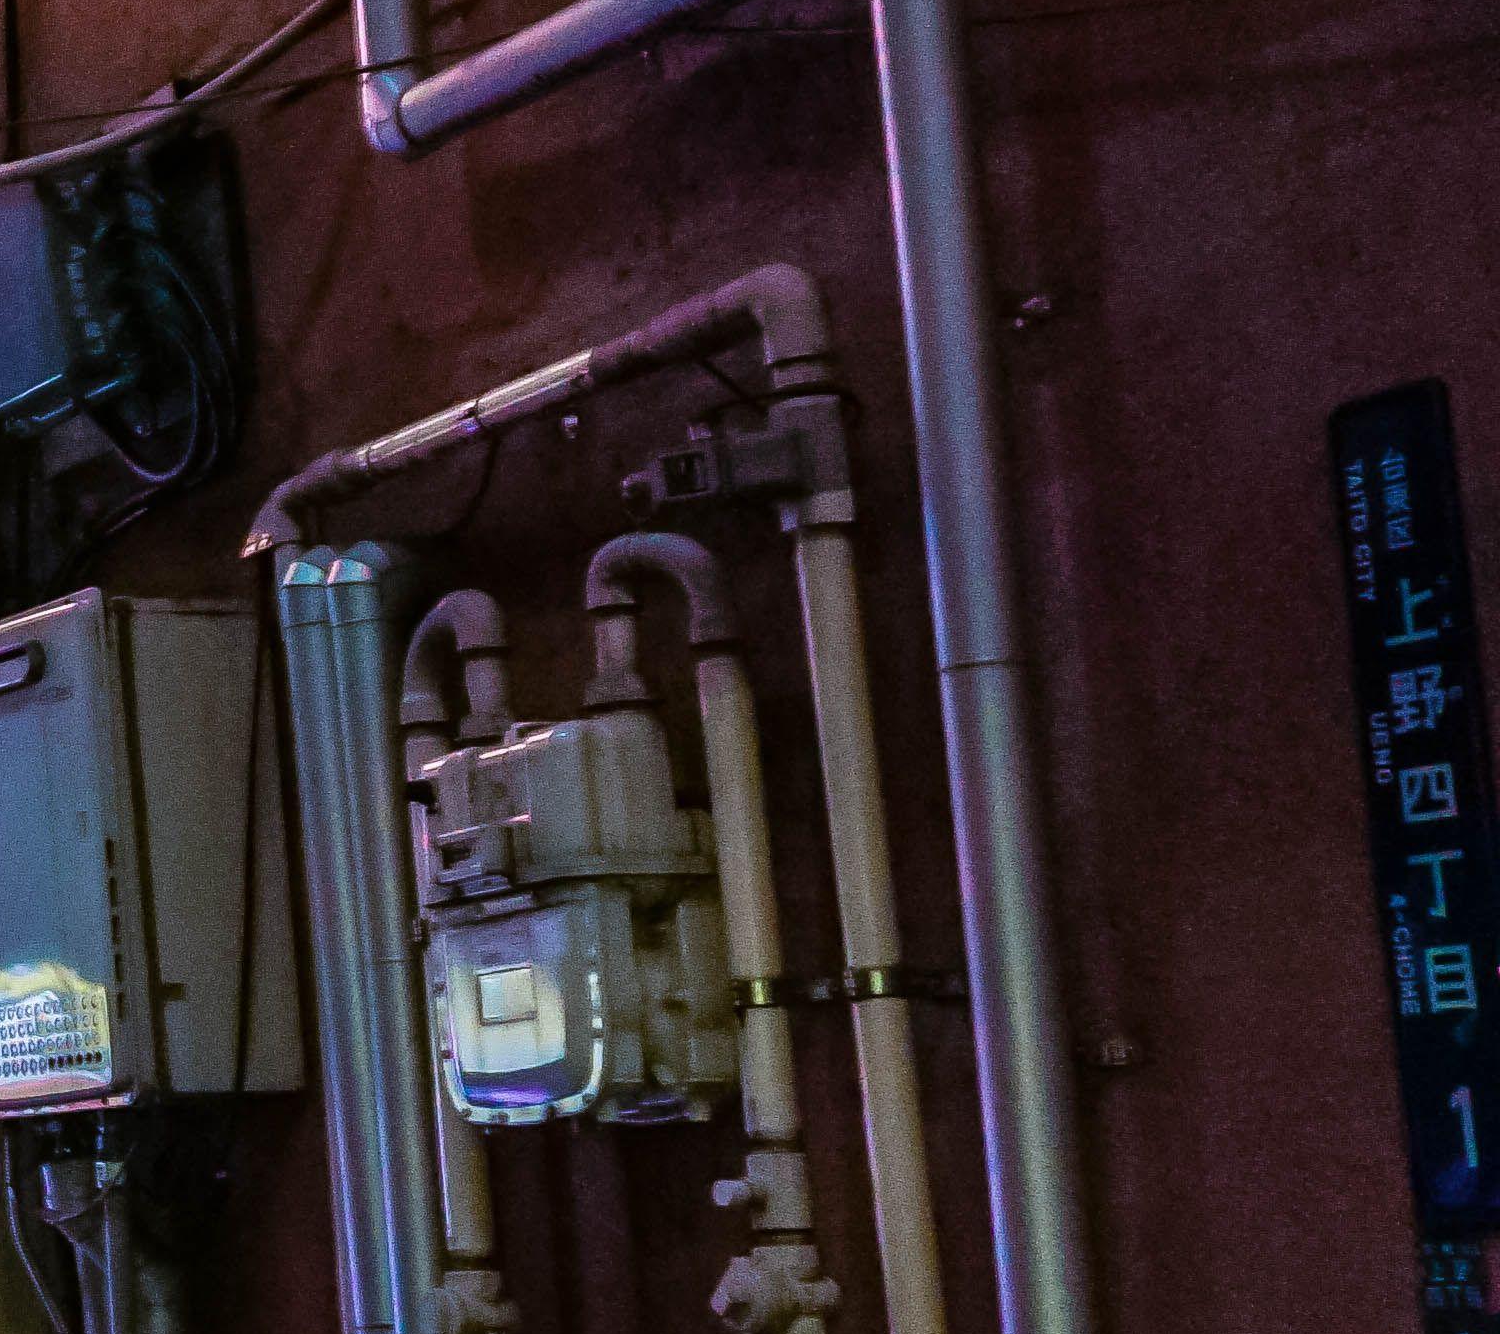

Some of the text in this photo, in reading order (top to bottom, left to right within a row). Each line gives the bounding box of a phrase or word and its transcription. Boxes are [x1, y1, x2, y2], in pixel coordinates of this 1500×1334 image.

[1368, 707, 1395, 786] UENO
[1383, 577, 1479, 1014] 上野四丁目
